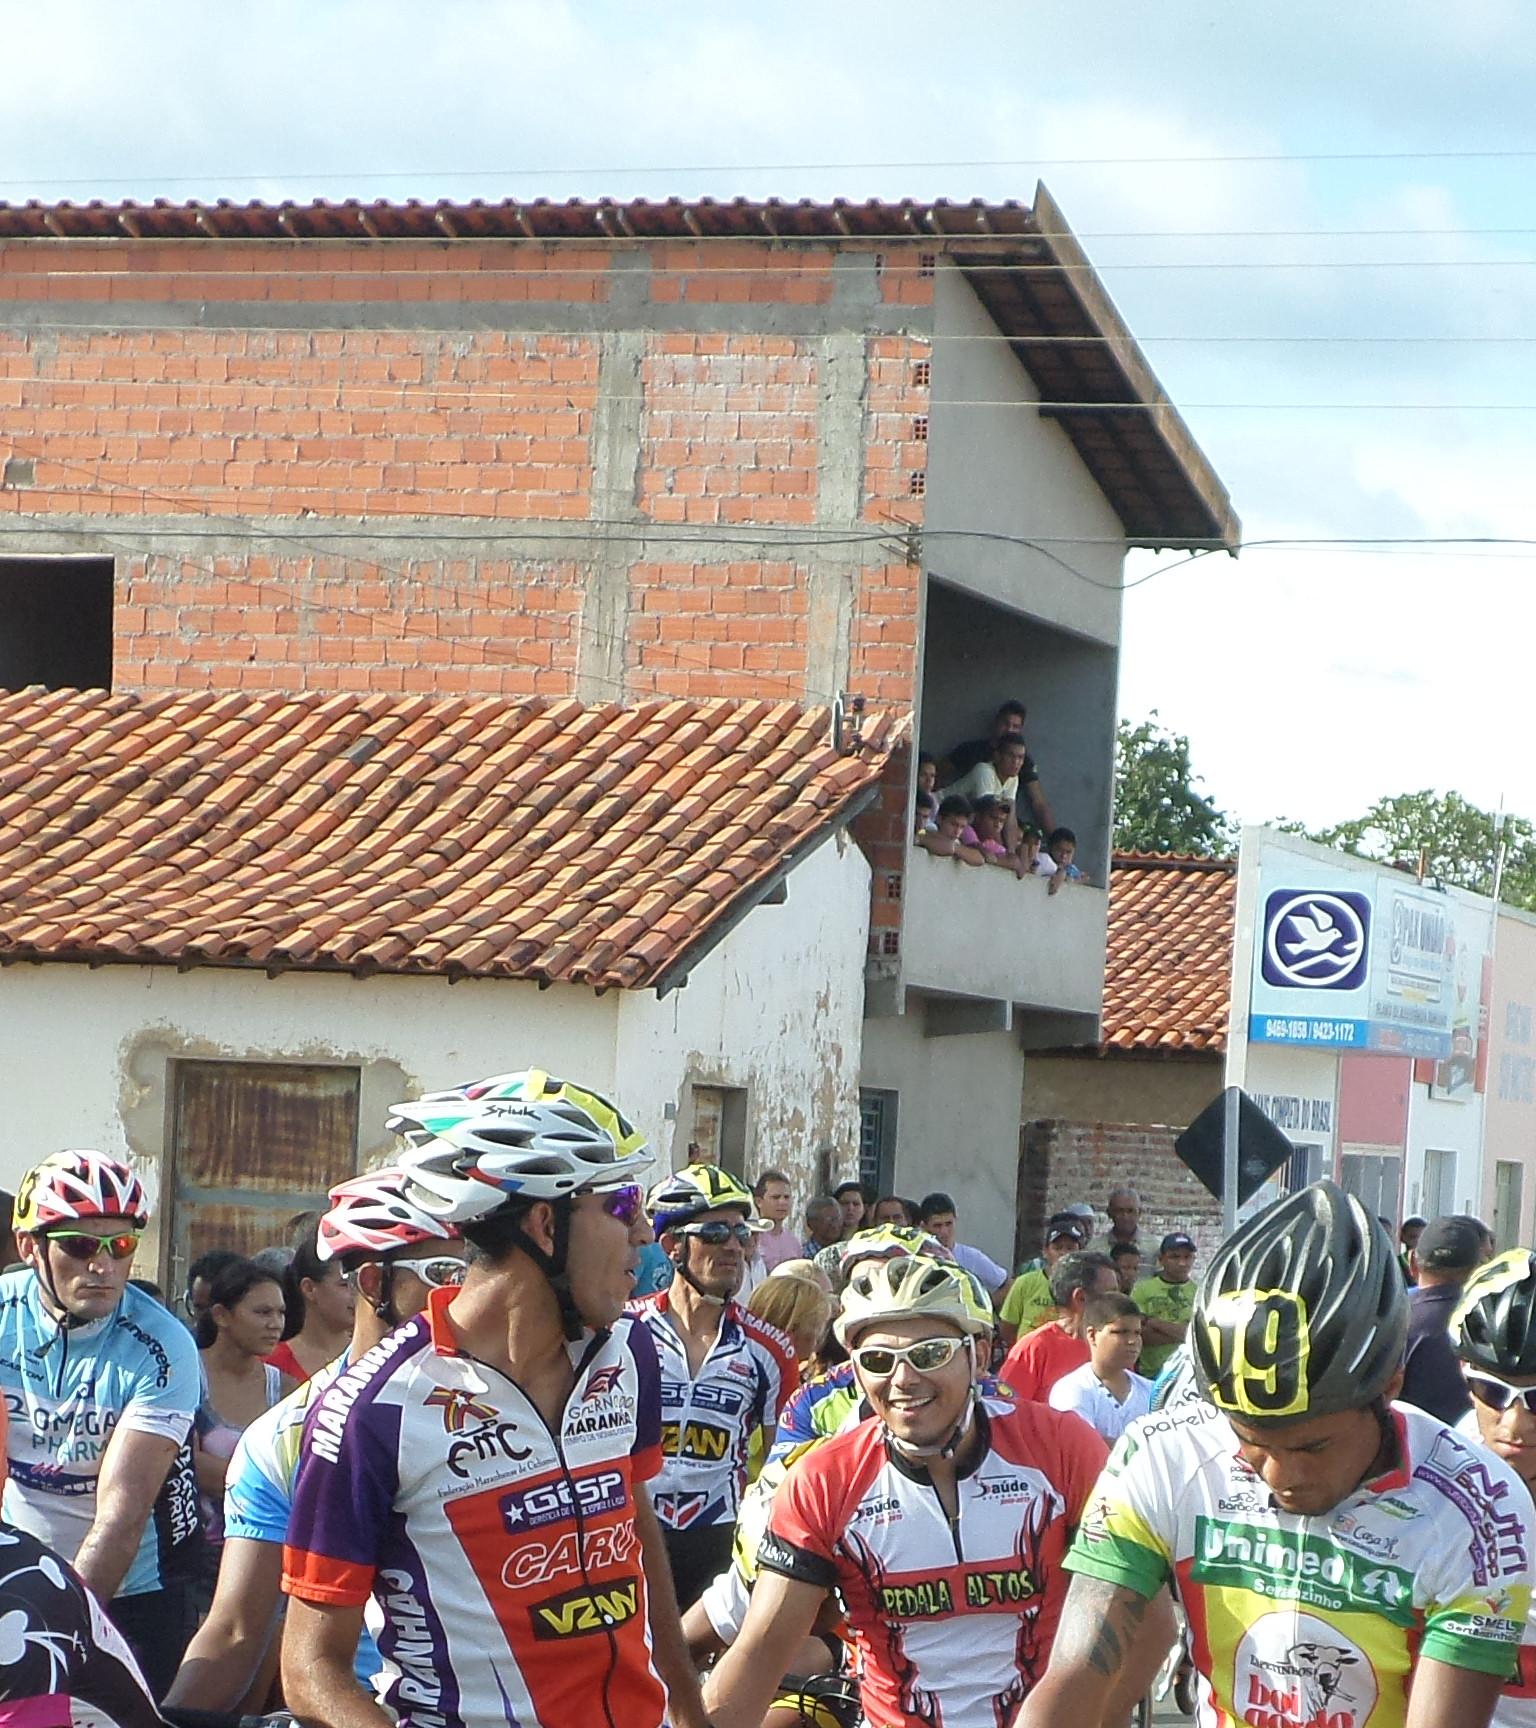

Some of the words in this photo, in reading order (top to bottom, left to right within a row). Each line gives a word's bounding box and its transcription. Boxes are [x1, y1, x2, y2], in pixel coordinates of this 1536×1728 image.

[1208, 1294, 1298, 1411] 19
[33, 1403, 117, 1441] OMEGA
[31, 1431, 111, 1462] PHARM
[1203, 1524, 1345, 1586] Unimed
[882, 1580, 952, 1618] PEDALA
[966, 1569, 1037, 1606] ALTOS
[1472, 1615, 1515, 1631] SMEL
[1248, 1673, 1300, 1716] boi
